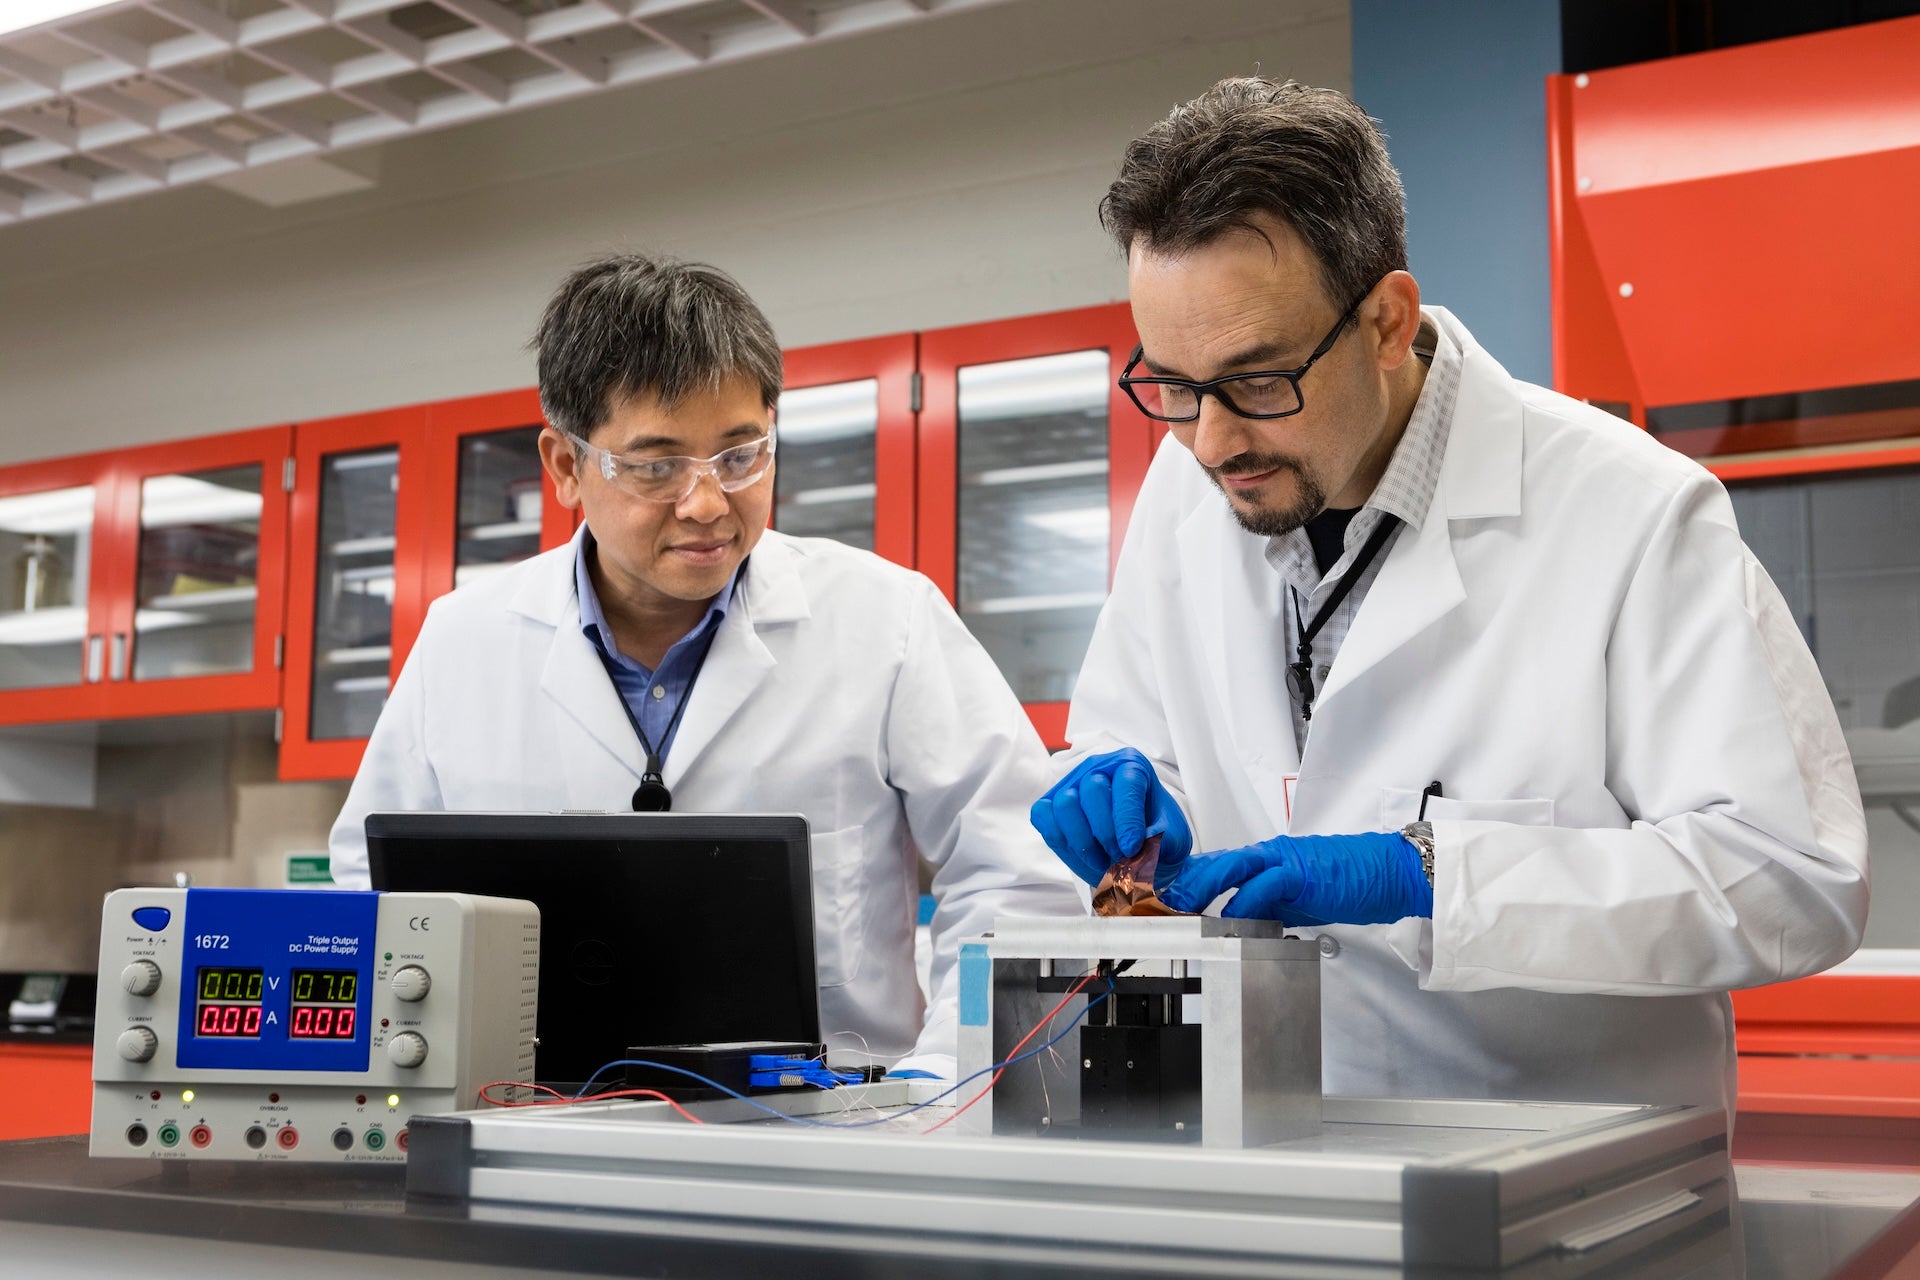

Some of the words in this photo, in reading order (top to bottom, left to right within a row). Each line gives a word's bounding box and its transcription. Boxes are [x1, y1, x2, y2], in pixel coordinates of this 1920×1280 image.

[194, 934, 230, 949] 1672
[308, 935, 330, 945] Triple
[332, 936, 359, 946] Output
[289, 944, 302, 953] DC
[303, 944, 329, 953] Power
[331, 945, 359, 955] Supply
[268, 976, 281, 991] V
[201, 1006, 263, 1034] 0.00
[265, 1010, 278, 1025] A
[293, 1008, 355, 1036] 0.00
